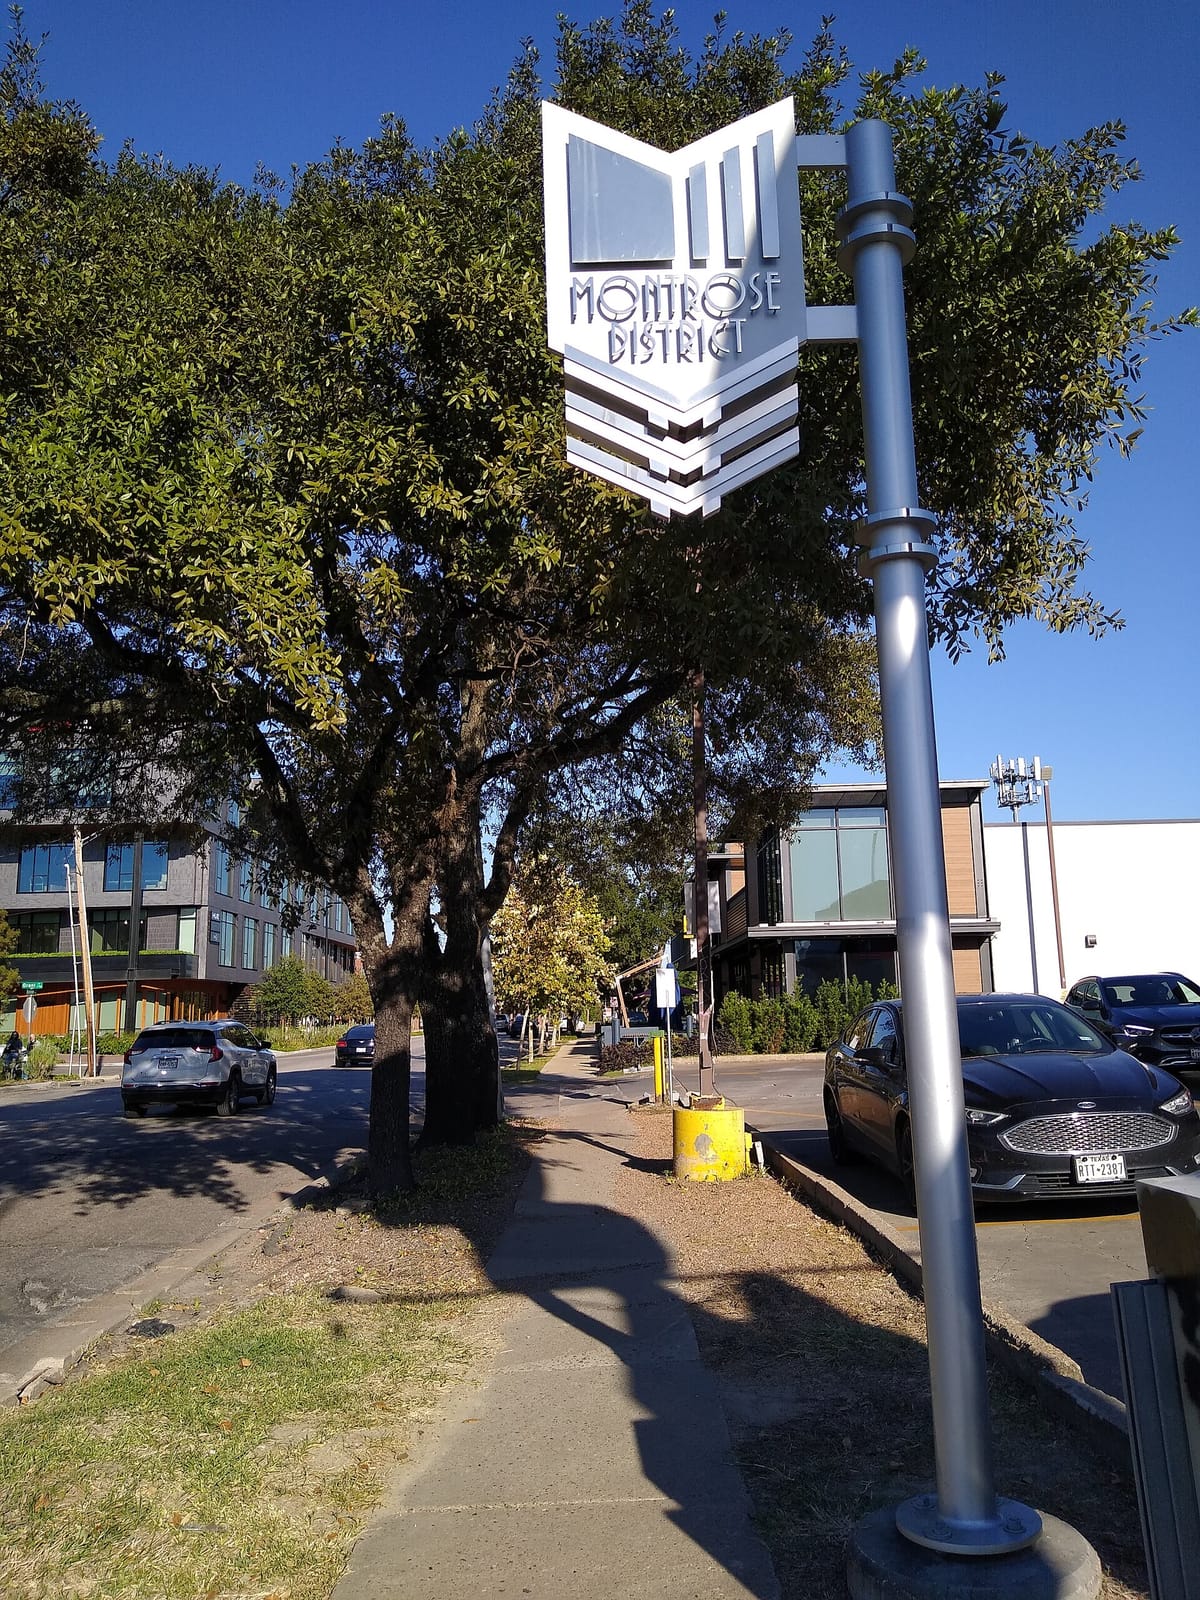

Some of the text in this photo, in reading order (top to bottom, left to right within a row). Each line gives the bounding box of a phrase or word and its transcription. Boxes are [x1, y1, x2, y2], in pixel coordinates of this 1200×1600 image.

[571, 272, 781, 319] MONTROSE
[610, 318, 746, 360] DISTRICT
[1090, 1154, 1110, 1162] TEXAS
